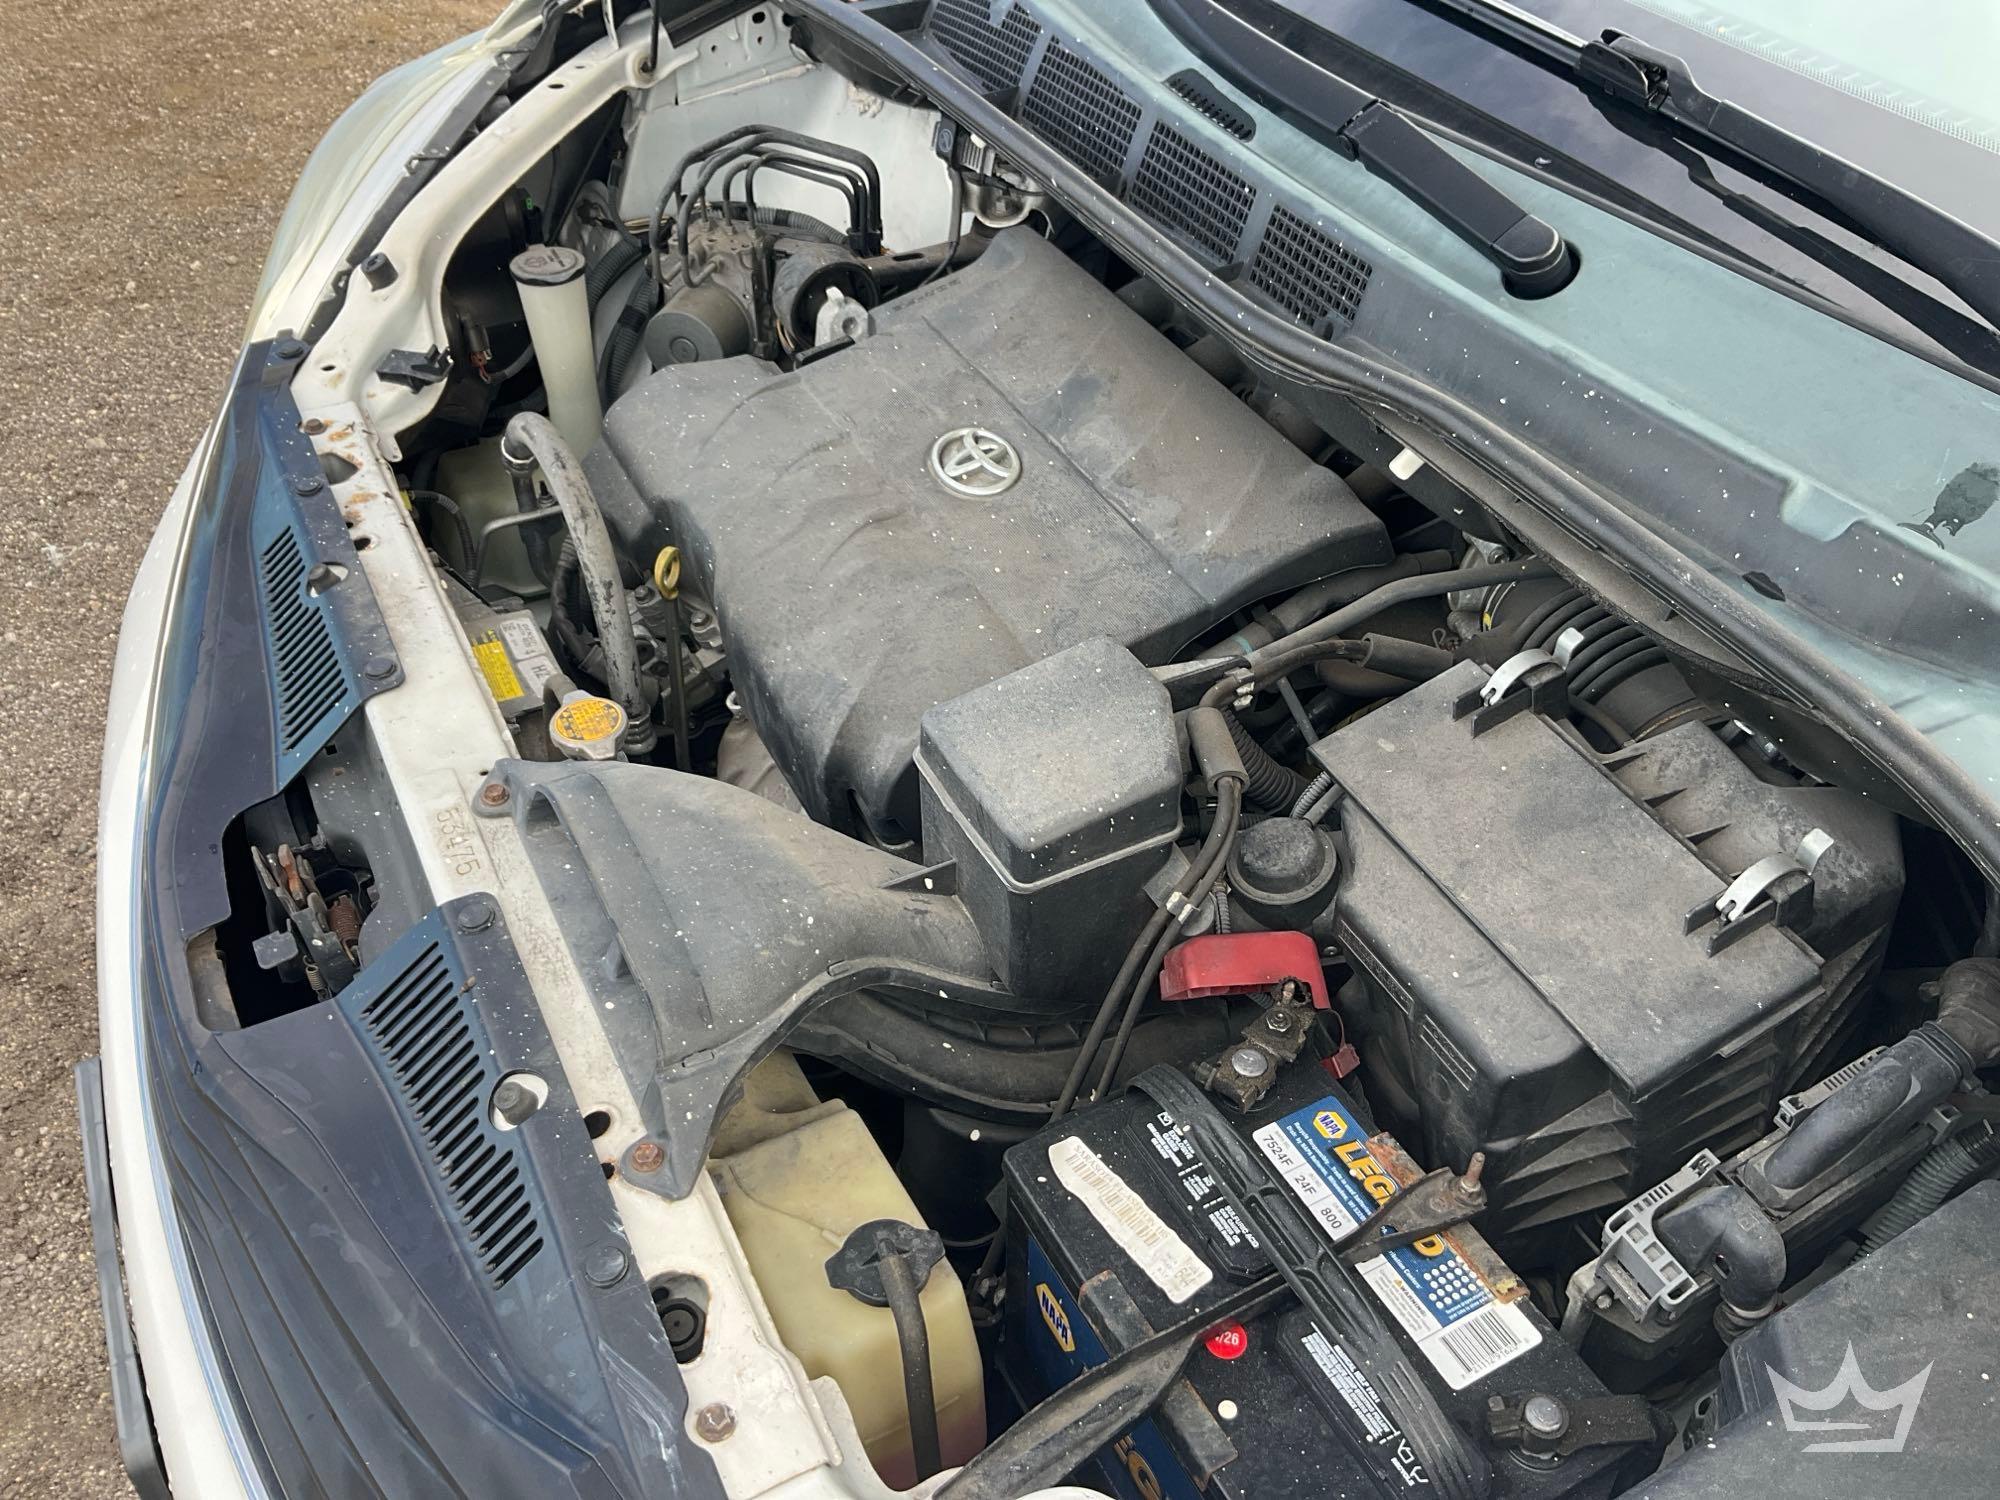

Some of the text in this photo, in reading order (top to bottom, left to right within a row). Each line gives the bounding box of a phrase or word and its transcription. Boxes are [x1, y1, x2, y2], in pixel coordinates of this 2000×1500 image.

[436, 808, 480, 874] 53475
[1318, 1114, 1342, 1136] NAPA
[1262, 1133, 1294, 1166] 7524F
[1295, 1175, 1317, 1195] 24F
[1333, 1140, 1446, 1256] LEGD
[1321, 1208, 1341, 1229] 800
[1042, 1291, 1070, 1344] NAPA
